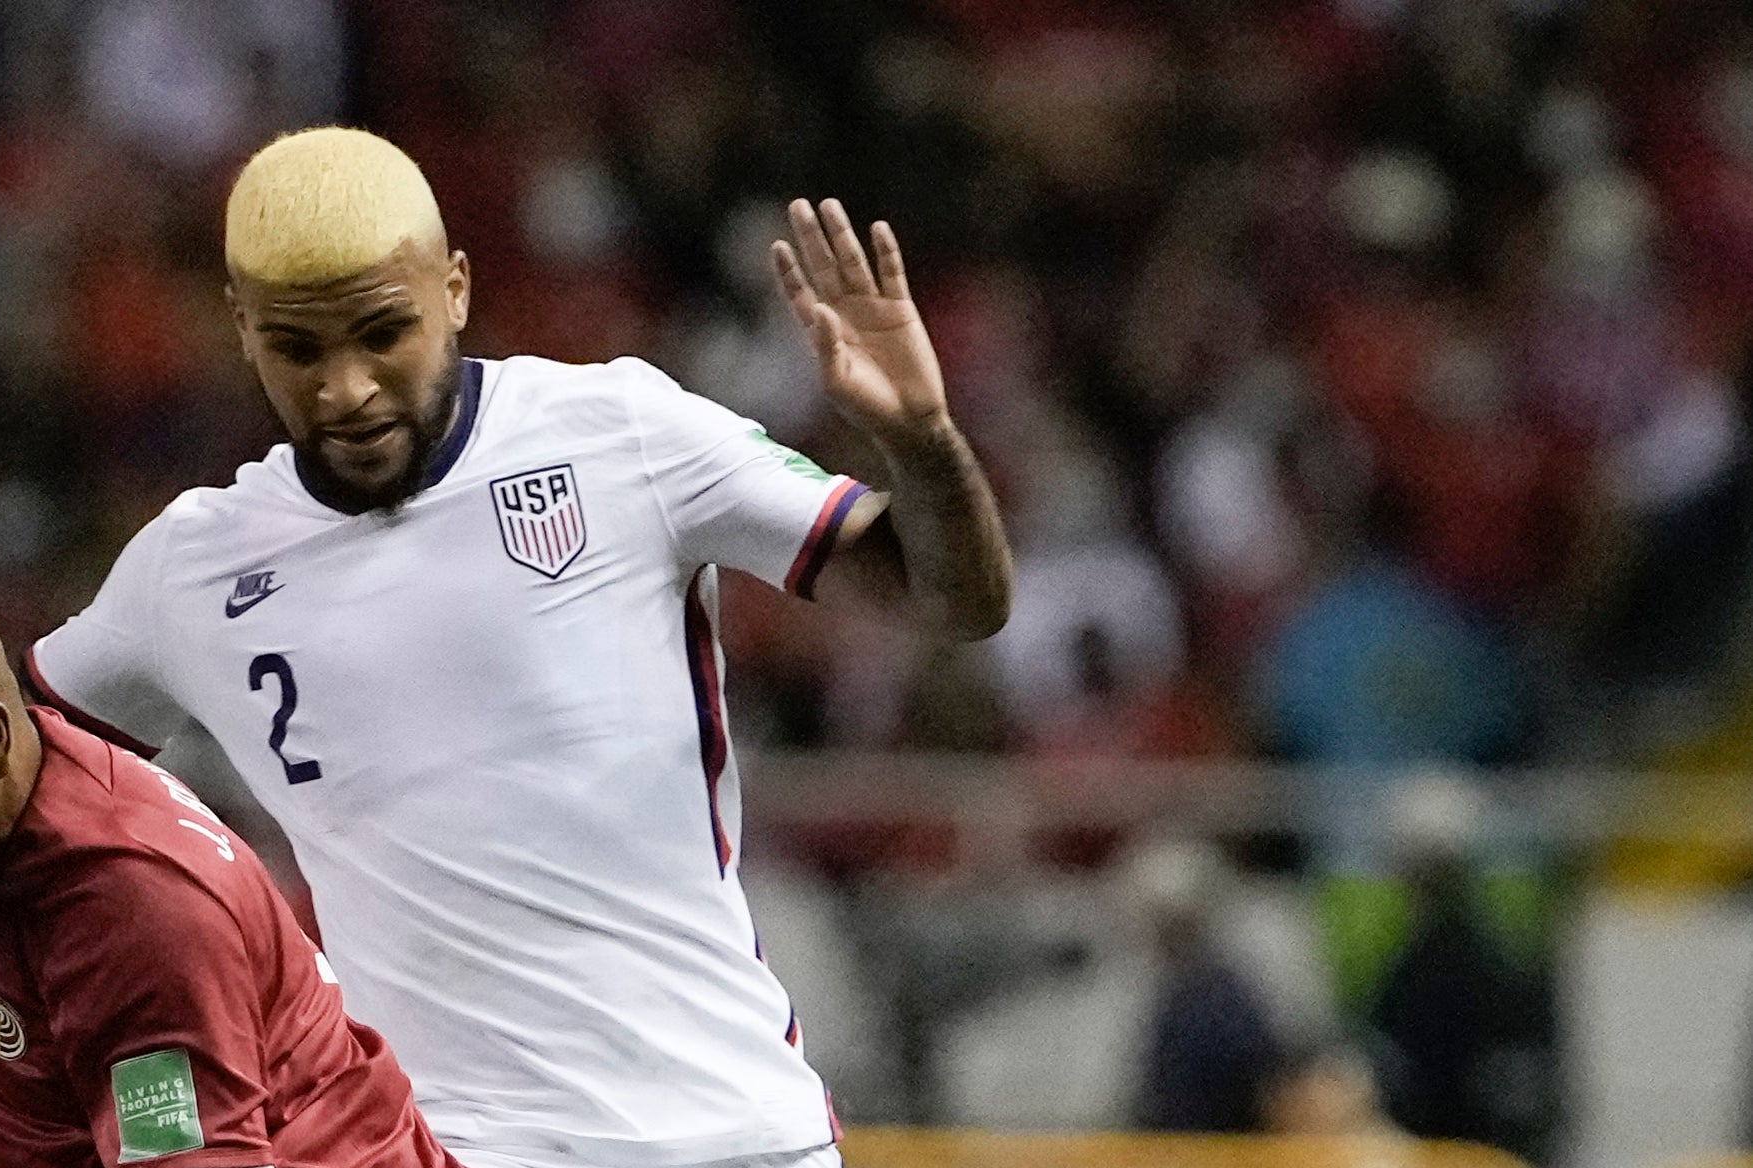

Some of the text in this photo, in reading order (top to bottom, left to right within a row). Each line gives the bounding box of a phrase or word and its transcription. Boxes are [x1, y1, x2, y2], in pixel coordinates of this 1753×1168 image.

[500, 473, 568, 515] USA
[233, 570, 277, 600] NIKE
[248, 653, 323, 785] 2
[119, 1078, 185, 1103] LIVING
[120, 1088, 187, 1115] FOOTBALL
[157, 1110, 190, 1128] FIFA
